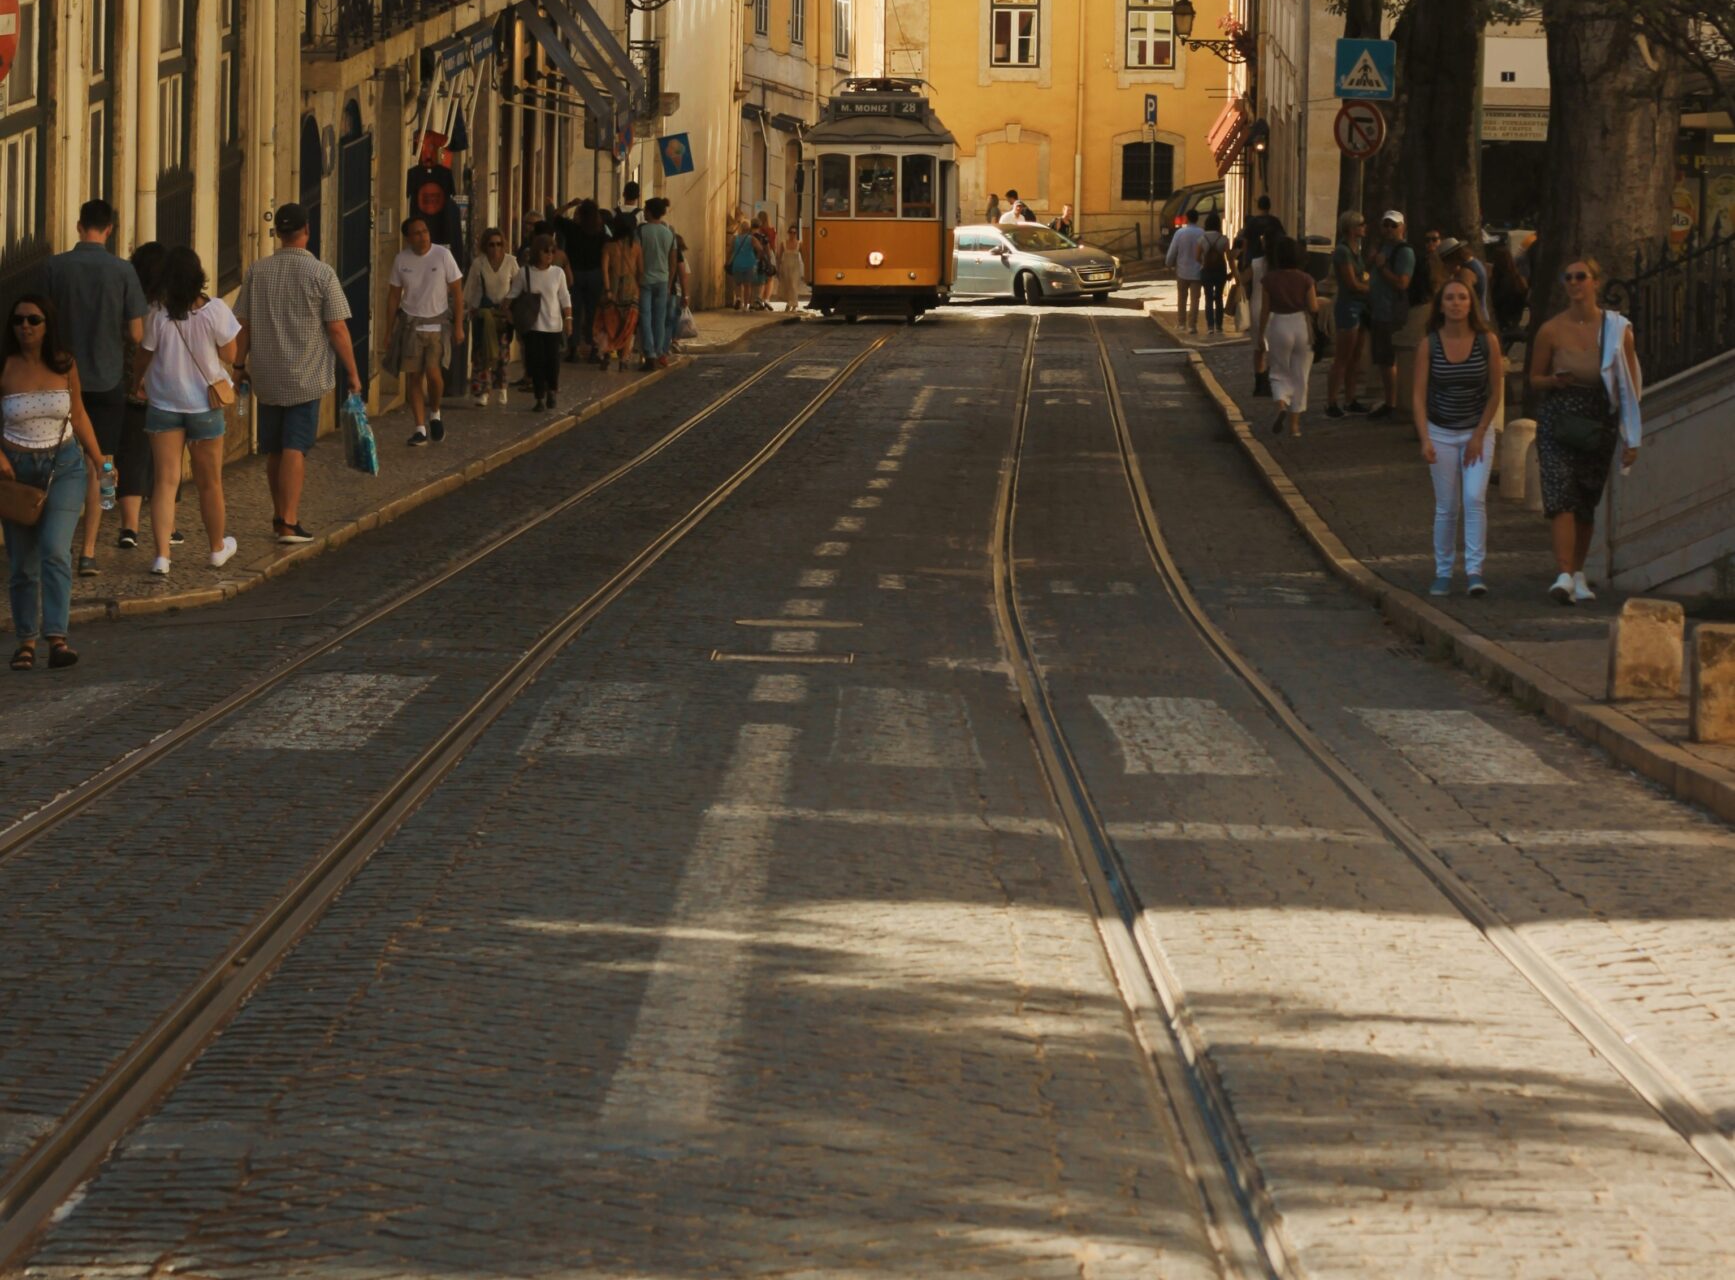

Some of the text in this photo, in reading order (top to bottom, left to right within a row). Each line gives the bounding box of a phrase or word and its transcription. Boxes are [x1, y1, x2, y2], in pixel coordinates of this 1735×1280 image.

[841, 104, 888, 112] M. MONIZ
[902, 102, 916, 113] 28
[1147, 98, 1155, 120] P
